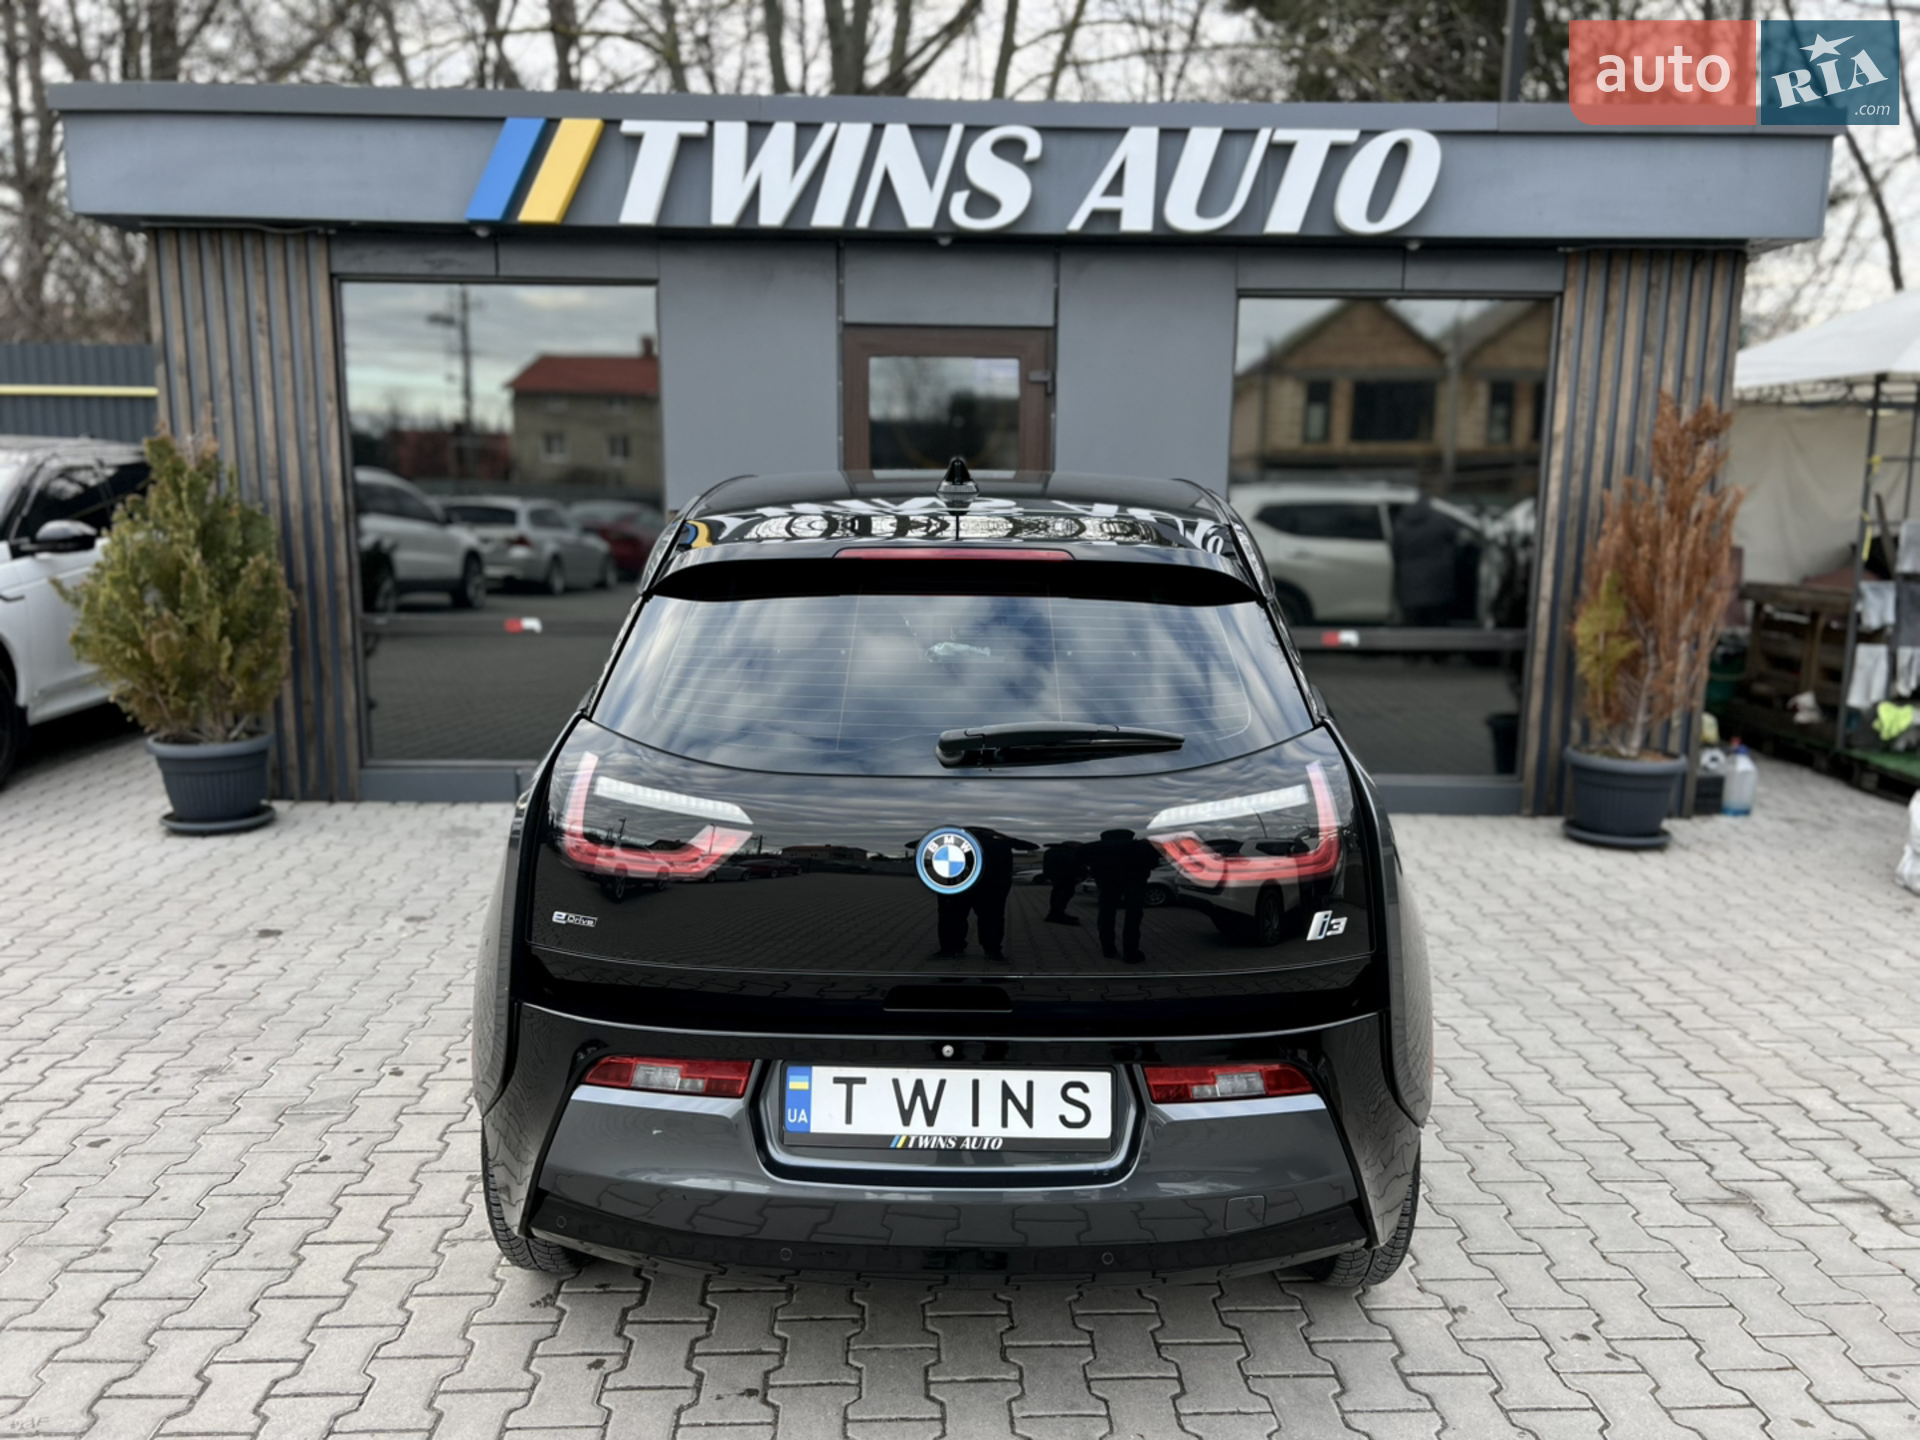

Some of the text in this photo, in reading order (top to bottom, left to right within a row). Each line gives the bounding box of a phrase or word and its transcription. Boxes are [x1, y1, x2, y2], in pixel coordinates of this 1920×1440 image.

[618, 120, 1444, 236] TWINS AUTO
[1306, 910, 1348, 941] i3
[787, 1108, 808, 1124] UA
[832, 1076, 1092, 1129] TWINS
[907, 1135, 1003, 1150] TWINS AUTO
